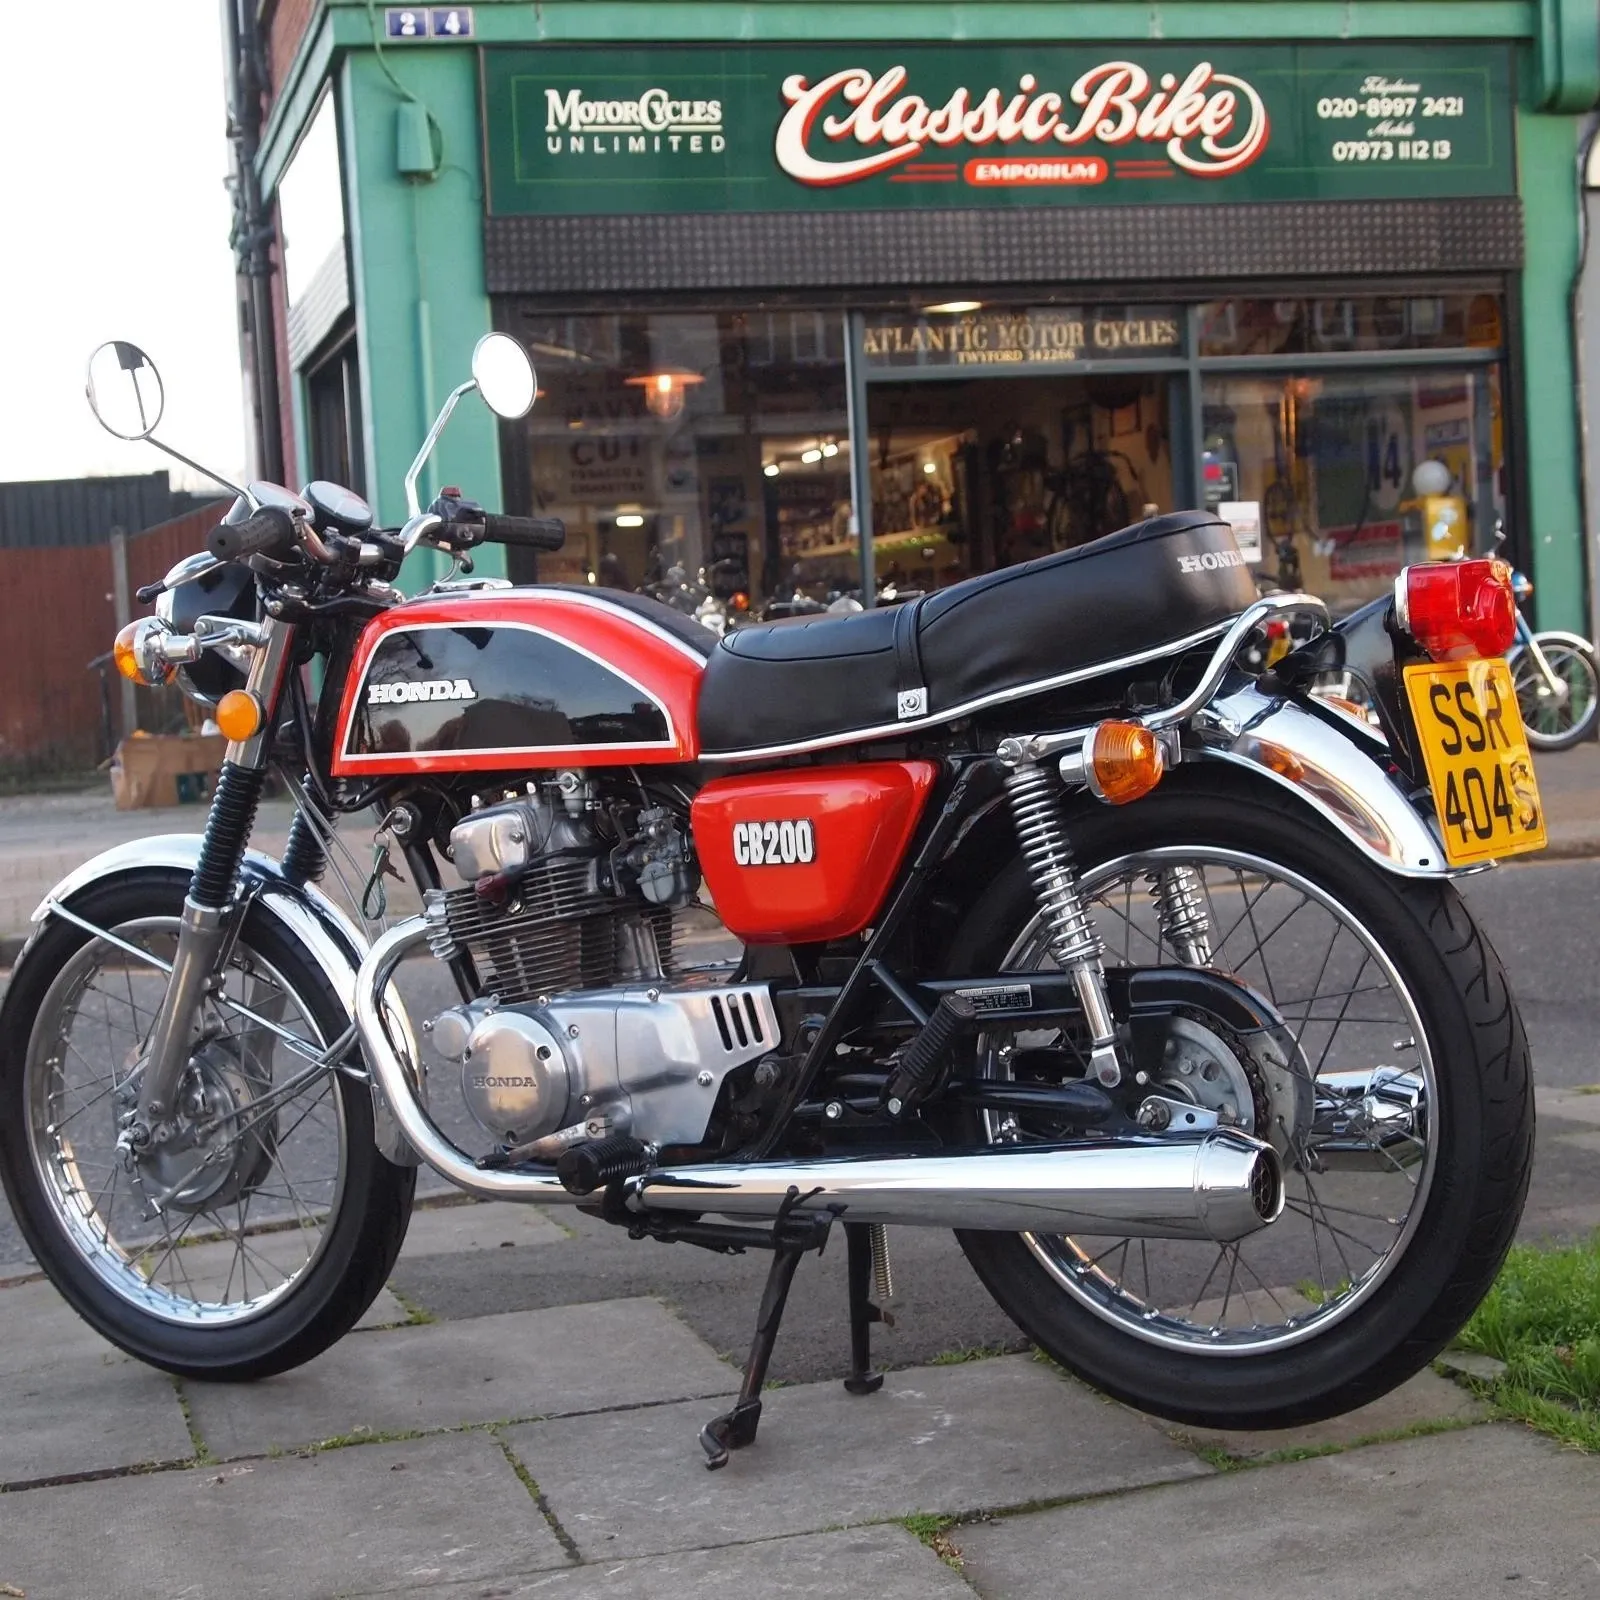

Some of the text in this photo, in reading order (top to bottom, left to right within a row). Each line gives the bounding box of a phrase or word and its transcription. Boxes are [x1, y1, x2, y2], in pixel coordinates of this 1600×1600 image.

[400, 11, 461, 35] 2 4
[1316, 96, 1464, 119] 020-8997 2421
[776, 61, 1270, 187] Classic Bike
[546, 135, 726, 154] UNLIMITED
[1332, 140, 1394, 162] 07973
[974, 161, 1099, 182] EMPORIUM
[863, 319, 1179, 353] ATLANTIC MOTOR CYCLES
[368, 678, 479, 705] HONDA
[1429, 679, 1511, 756] SSR
[732, 818, 815, 866] CB200
[472, 1076, 537, 1089] HONDA
